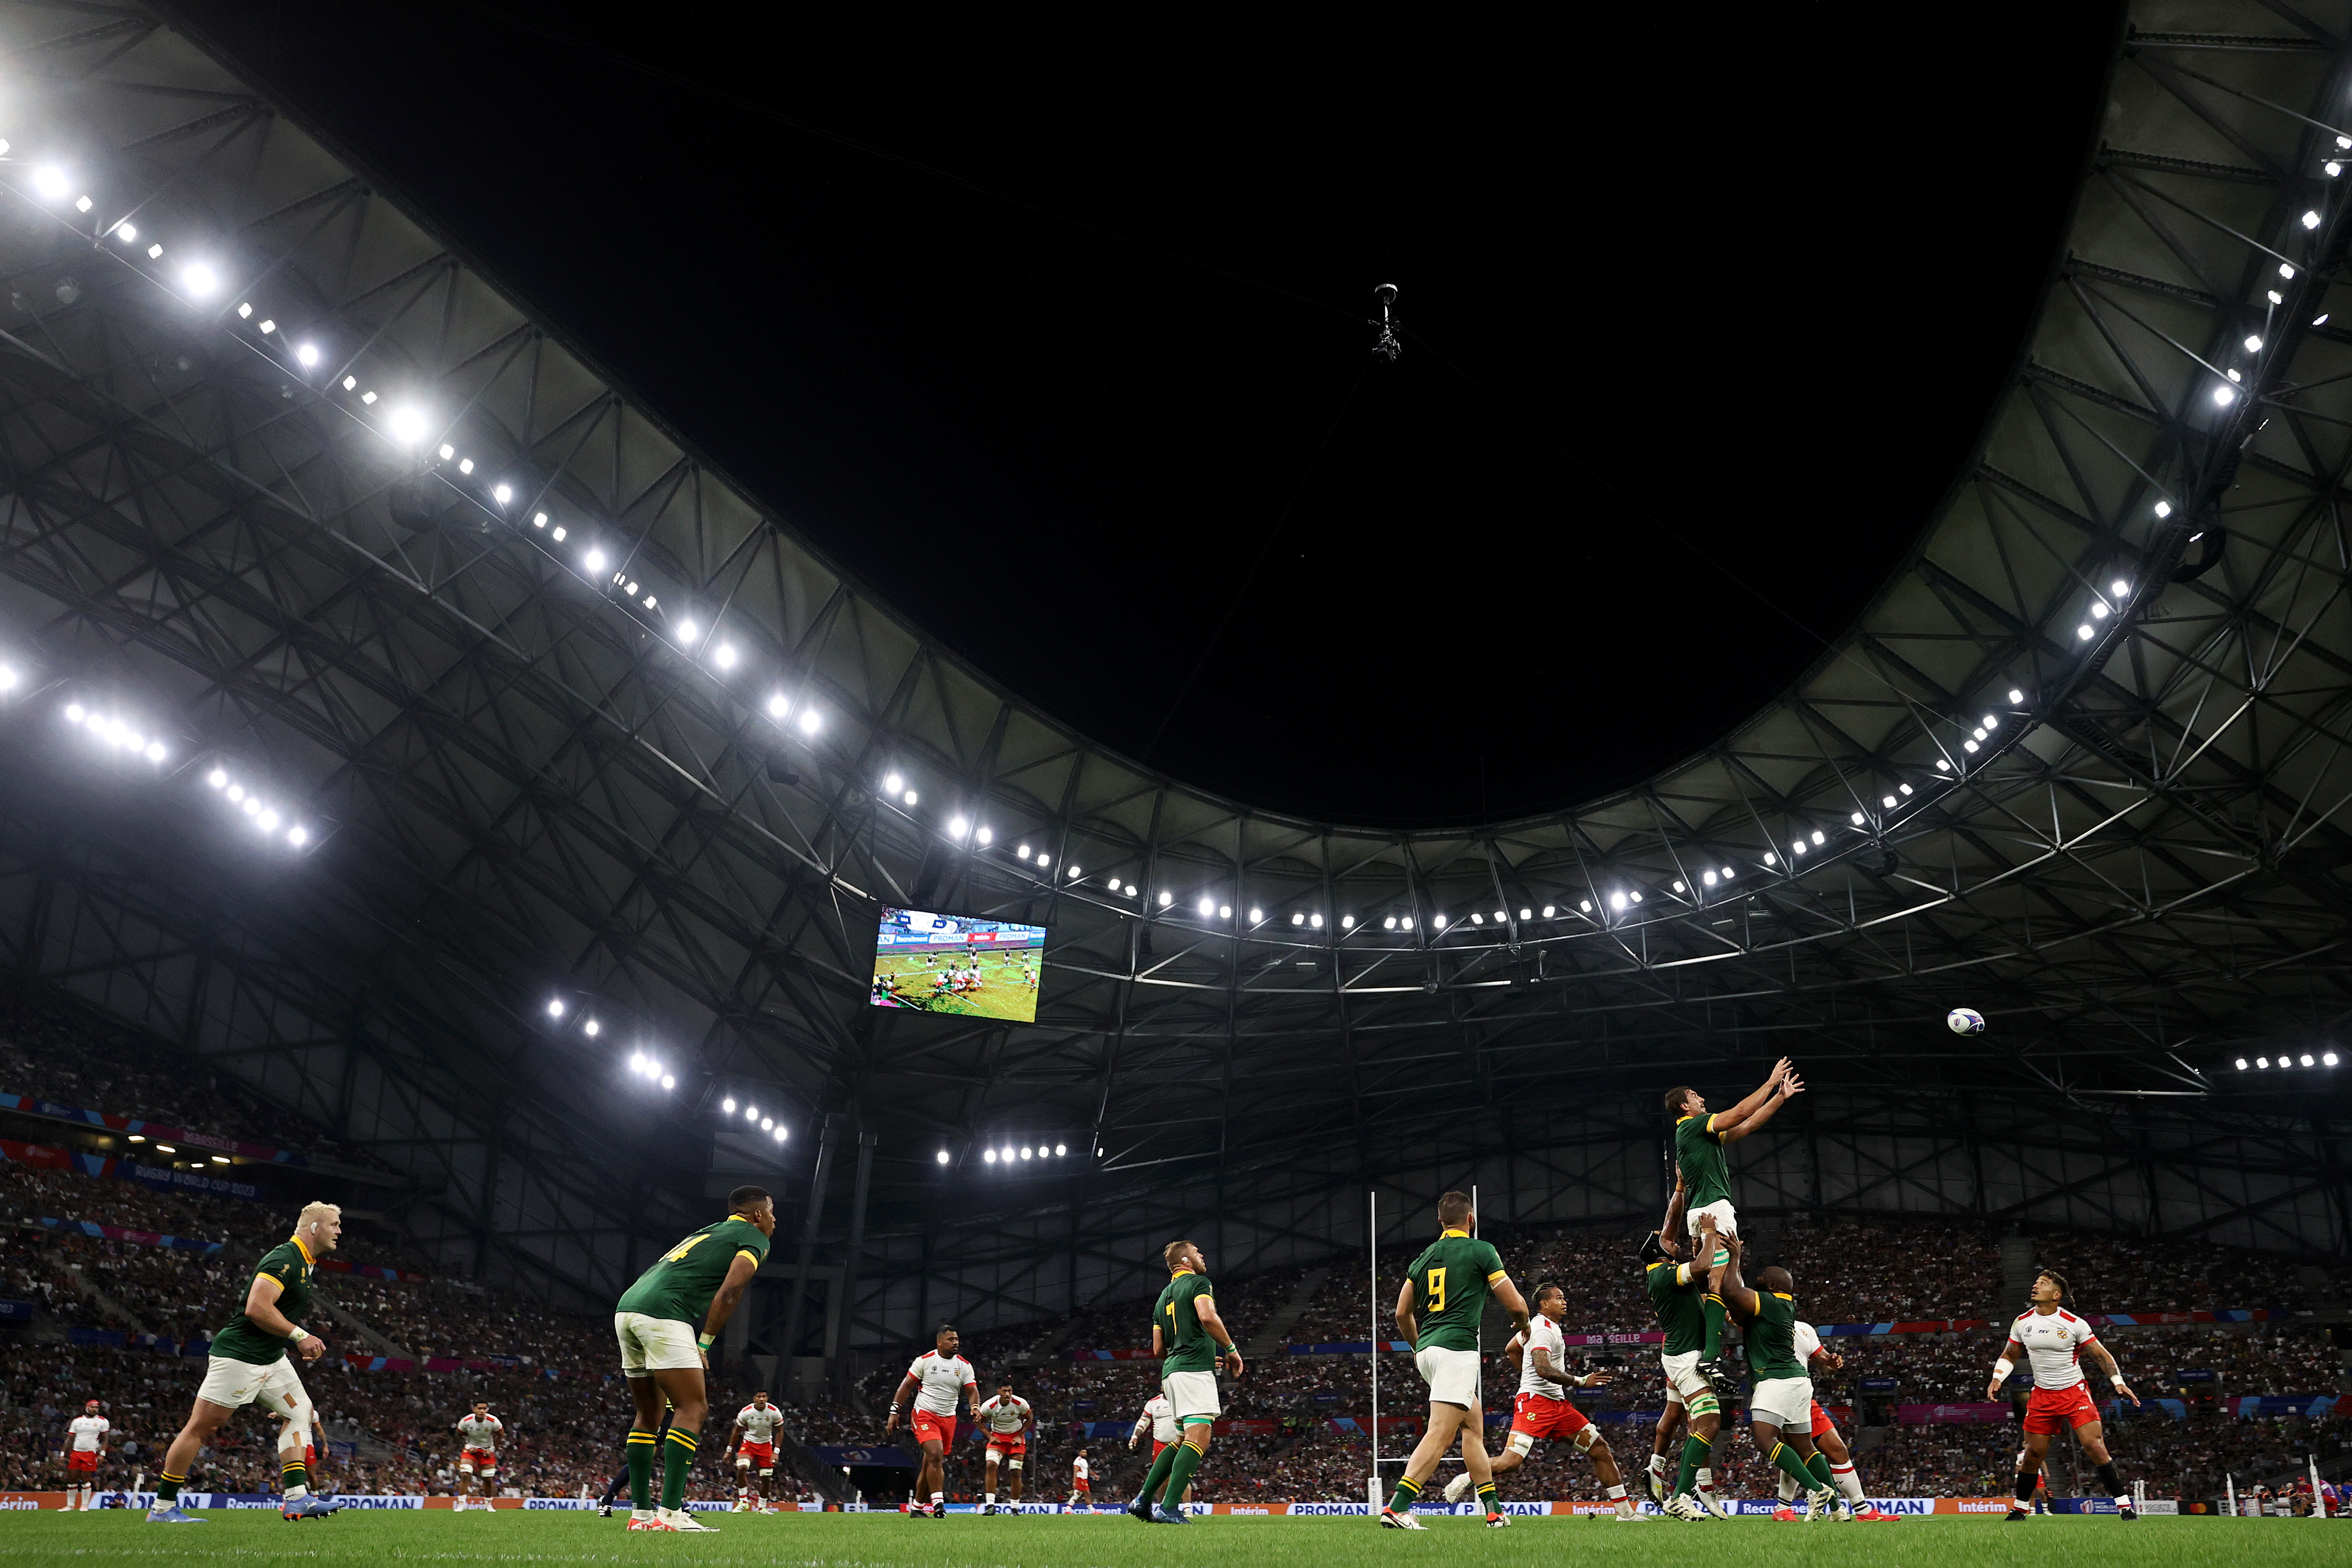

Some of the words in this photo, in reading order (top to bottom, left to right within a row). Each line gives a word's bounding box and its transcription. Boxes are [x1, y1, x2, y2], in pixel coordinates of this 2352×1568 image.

[173, 1172, 209, 1189] WORLD
[211, 1179, 230, 1192] CUP
[1427, 1267, 1447, 1312] 9
[1165, 1300, 1177, 1335] 7
[0, 1496, 39, 1509] érim
[226, 1498, 283, 1509] Recruit
[690, 1502, 727, 1511] OMAN
[1958, 1501, 2007, 1513] Intérim
[1230, 1506, 1269, 1515] Intérim
[1295, 1505, 1368, 1515] PROMAN
[1465, 1505, 1541, 1515] PMAN
